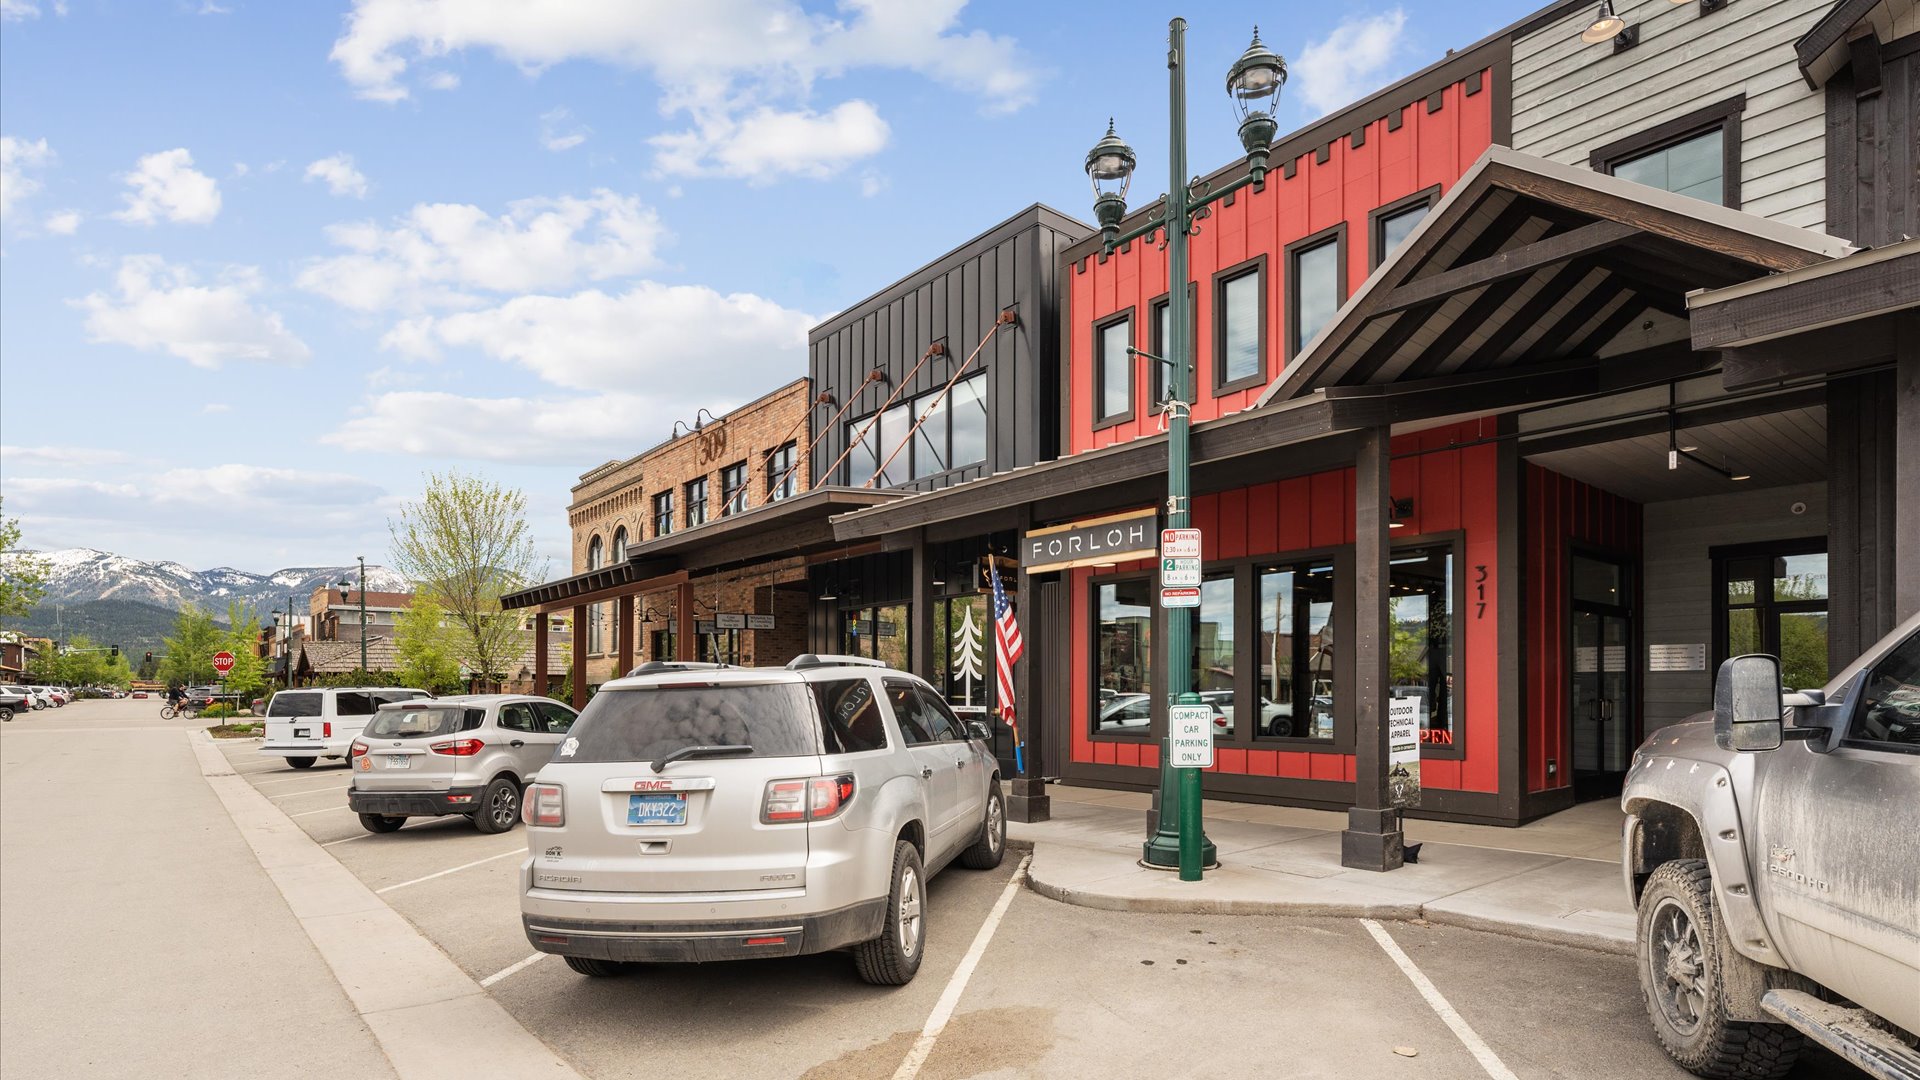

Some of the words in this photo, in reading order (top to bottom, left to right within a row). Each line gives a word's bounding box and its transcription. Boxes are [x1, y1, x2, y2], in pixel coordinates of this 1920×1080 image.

[700, 428, 726, 465] 309
[1033, 525, 1143, 558] FORLOH
[1165, 533, 1175, 541] NO
[1176, 533, 1198, 541] PARKING
[1166, 560, 1173, 570] 2
[1474, 565, 1489, 619] 317
[214, 657, 233, 666] STOP
[1174, 711, 1208, 720] COMPACT
[1390, 706, 1413, 716] OUTDOOR
[1184, 725, 1199, 733] CAR
[1391, 729, 1411, 739] APPAREL
[1175, 739, 1208, 748] PARKING
[1181, 753, 1202, 761] ONLY
[634, 780, 673, 791] GMC
[638, 802, 676, 817] DKY322
[538, 874, 583, 883] ACADIA
